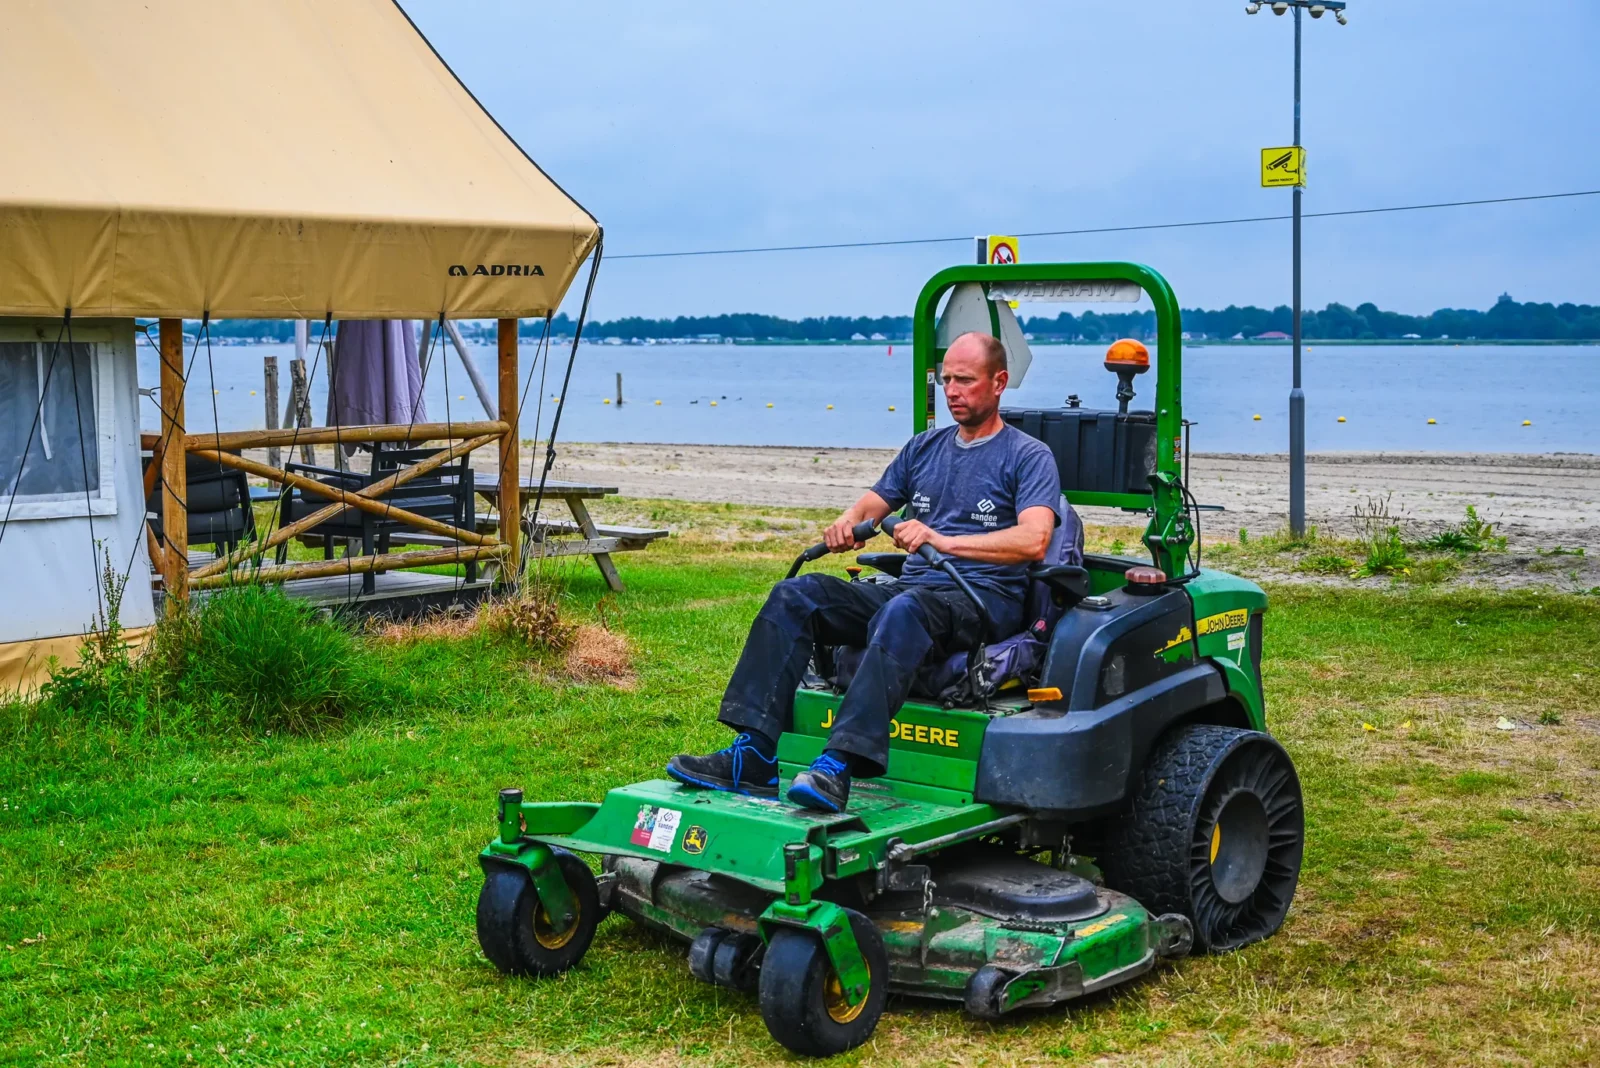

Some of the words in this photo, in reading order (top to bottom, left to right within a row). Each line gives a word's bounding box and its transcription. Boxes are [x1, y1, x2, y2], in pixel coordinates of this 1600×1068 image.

[472, 264, 545, 276] ADRIA
[970, 513, 998, 522] sandee
[1206, 617, 1225, 634] JOHN
[1225, 613, 1245, 629] DEERE
[889, 718, 960, 748] DEERE
